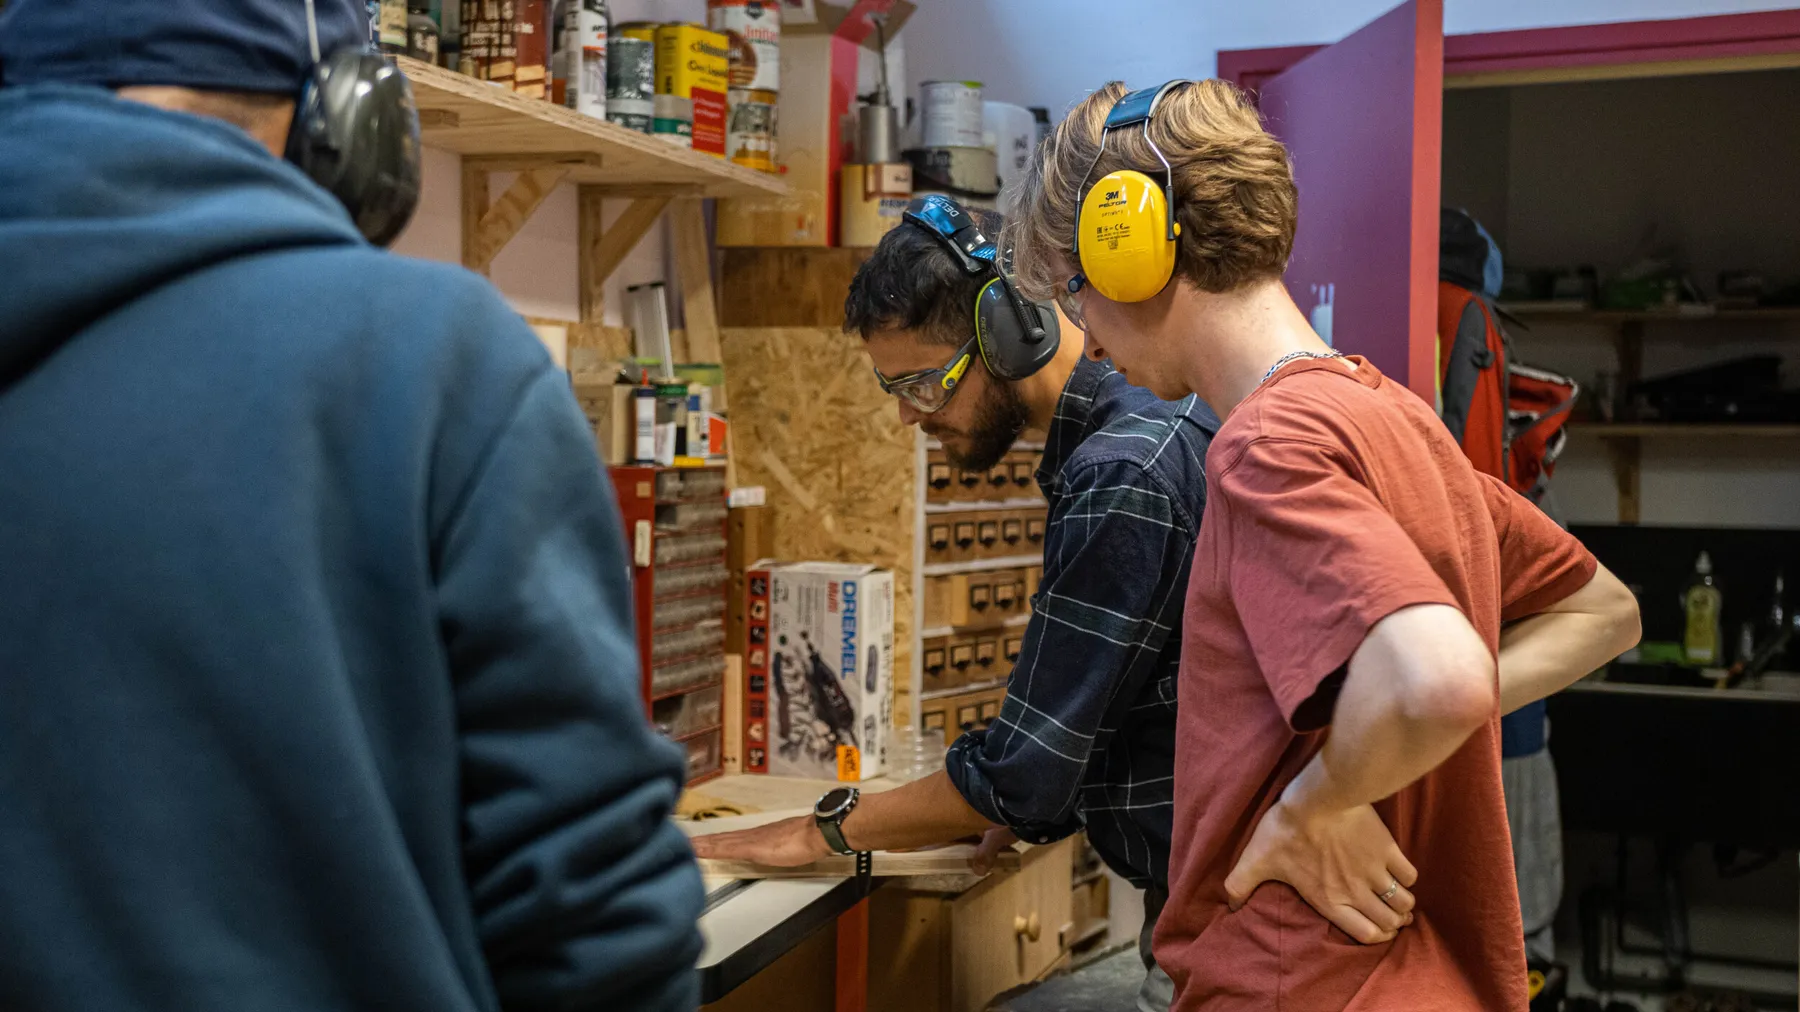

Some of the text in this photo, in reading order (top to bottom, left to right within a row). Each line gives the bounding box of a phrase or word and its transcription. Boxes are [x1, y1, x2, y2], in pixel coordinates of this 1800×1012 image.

[1098, 200, 1127, 208] PELTOR
[1105, 190, 1119, 200] 3M
[827, 579, 839, 614] Multi
[841, 580, 857, 680] DREMEL
